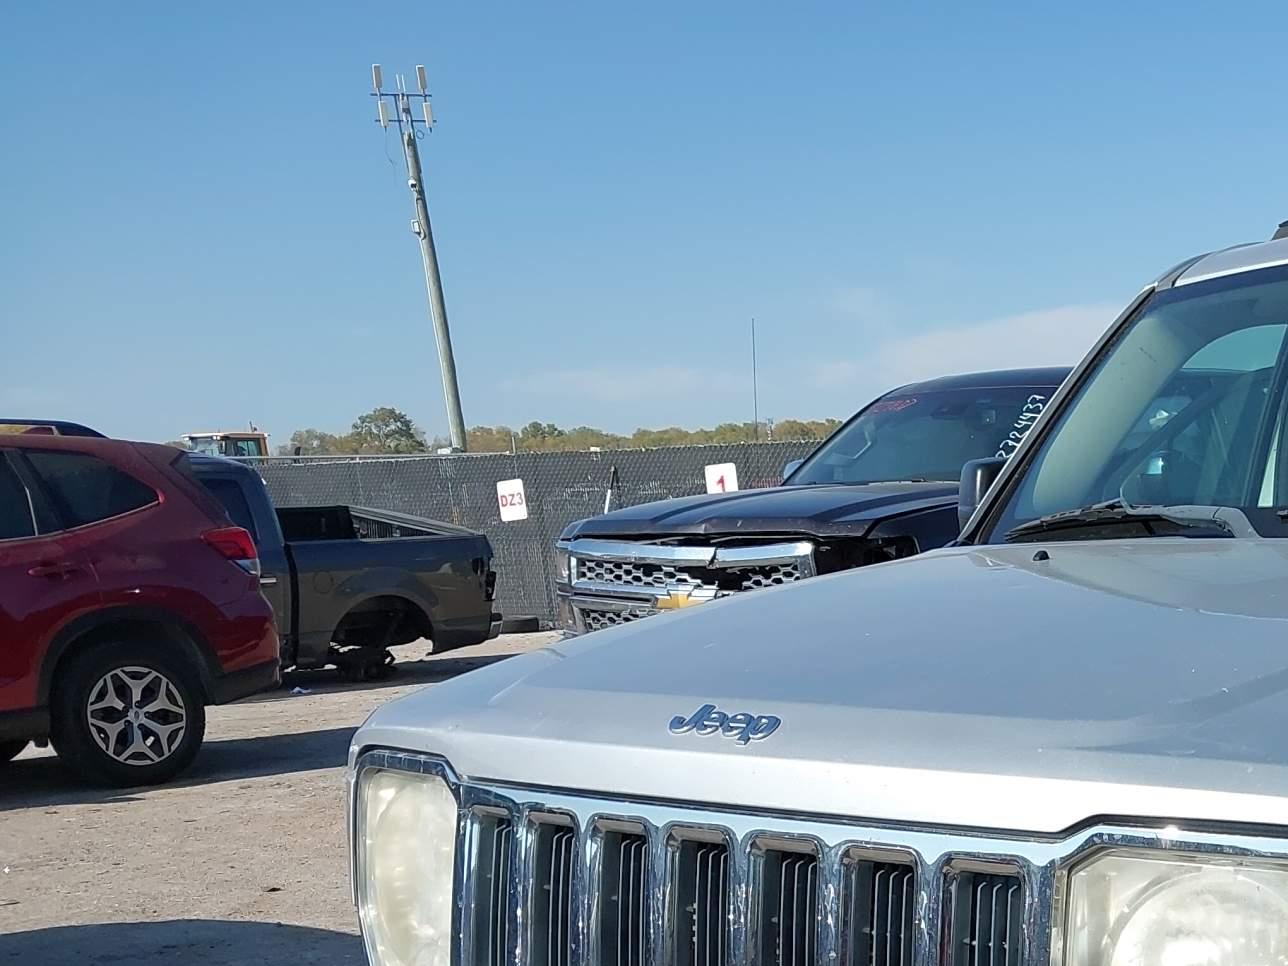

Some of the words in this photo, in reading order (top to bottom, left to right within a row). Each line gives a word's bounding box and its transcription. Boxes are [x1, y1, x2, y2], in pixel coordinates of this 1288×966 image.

[716, 475, 726, 493] 1
[500, 493, 524, 508] DZ3
[669, 703, 782, 746] Jeep
